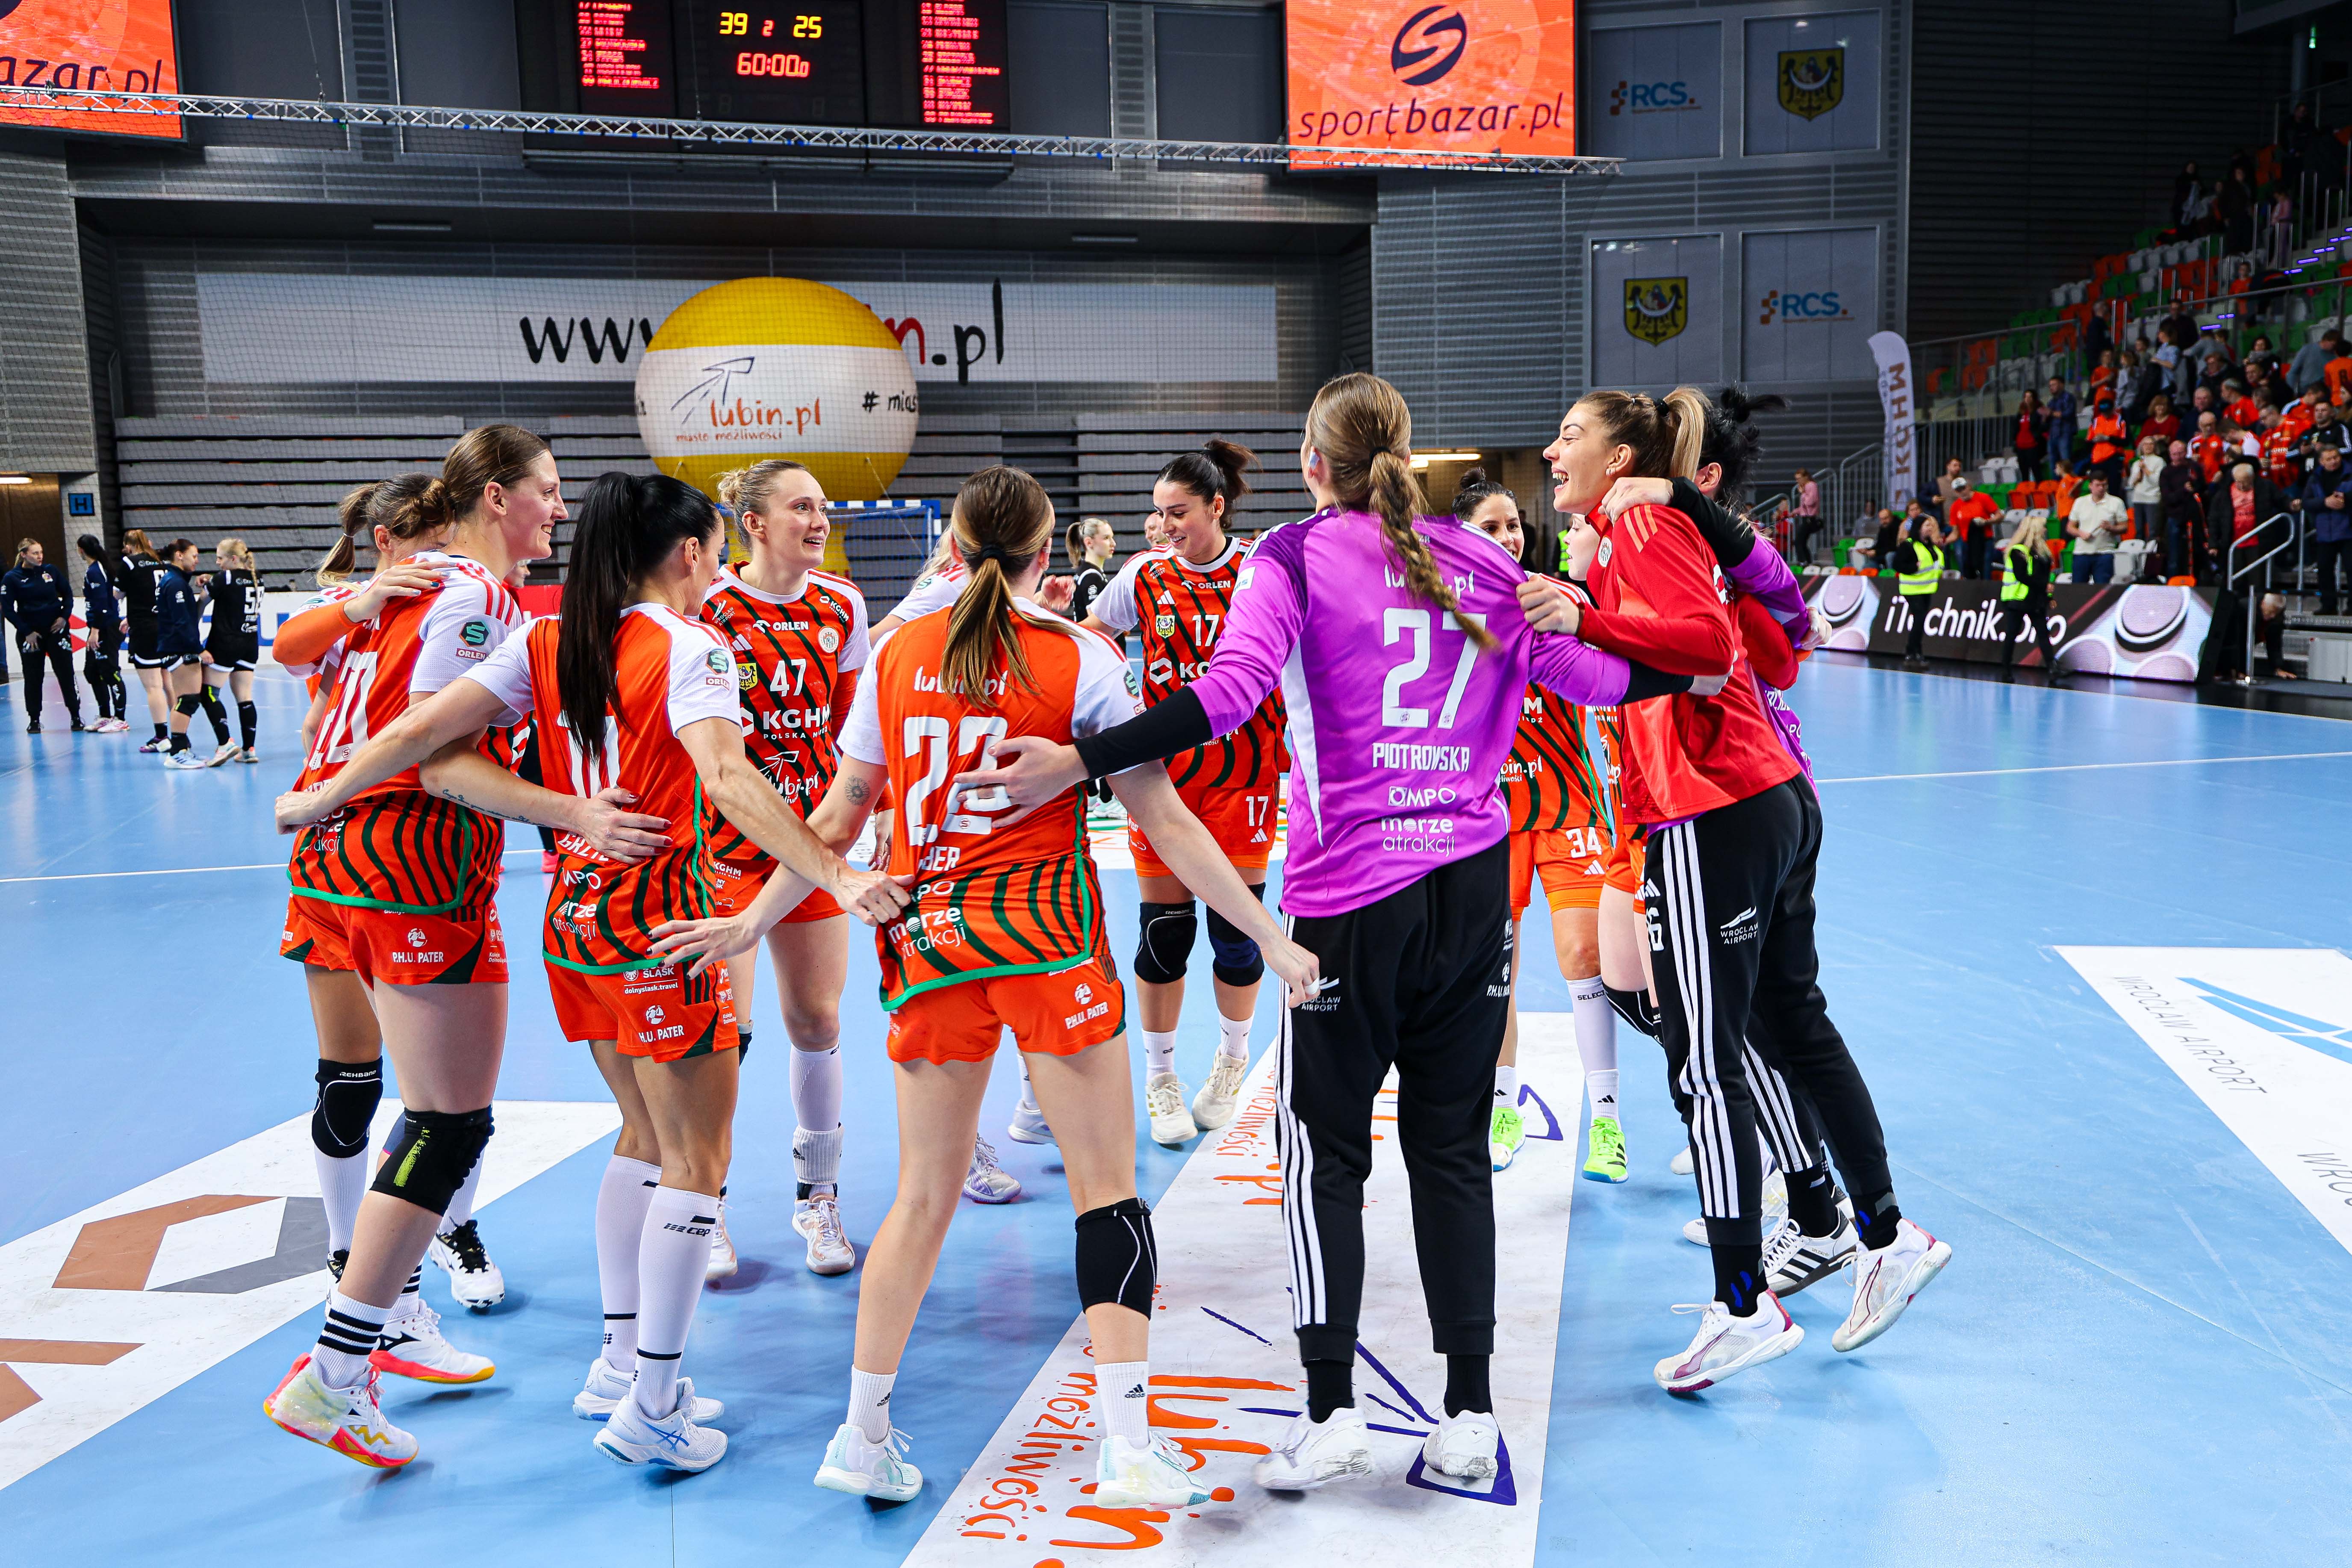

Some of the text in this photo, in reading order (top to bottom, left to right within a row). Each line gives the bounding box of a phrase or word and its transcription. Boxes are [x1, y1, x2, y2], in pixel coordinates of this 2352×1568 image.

[719, 12, 749, 35] 39
[793, 15, 822, 38] 25
[1298, 92, 1563, 144] sportbazar.pl
[710, 397, 821, 436] lubin.pl
[1198, 580, 1231, 589] ORLEN
[1384, 565, 1474, 600] lu.pl
[830, 601, 849, 622] KGHM
[772, 621, 809, 631] ORLEN
[1192, 614, 1220, 647] 17
[458, 648, 486, 660] ORLEN
[770, 659, 807, 697] 47
[1382, 607, 1487, 729] 27
[763, 704, 831, 730] KGHM
[1373, 742, 1470, 772] PIOTROWSKA
[1246, 796, 1269, 826] 17
[1382, 836, 1455, 857] atrakcji
[1566, 826, 1602, 858] 34
[714, 861, 742, 877] KGHM
[1724, 931, 1757, 945] AIRPORT
[418, 951, 444, 963] PATER
[624, 982, 678, 995] dolnyslask.travel
[1577, 990, 1605, 1001] SELECT
[1302, 1002, 1338, 1012] AIRPORT
[657, 1024, 684, 1040] PATER
[2114, 976, 2268, 1093] WROCLAW AIRPORT
